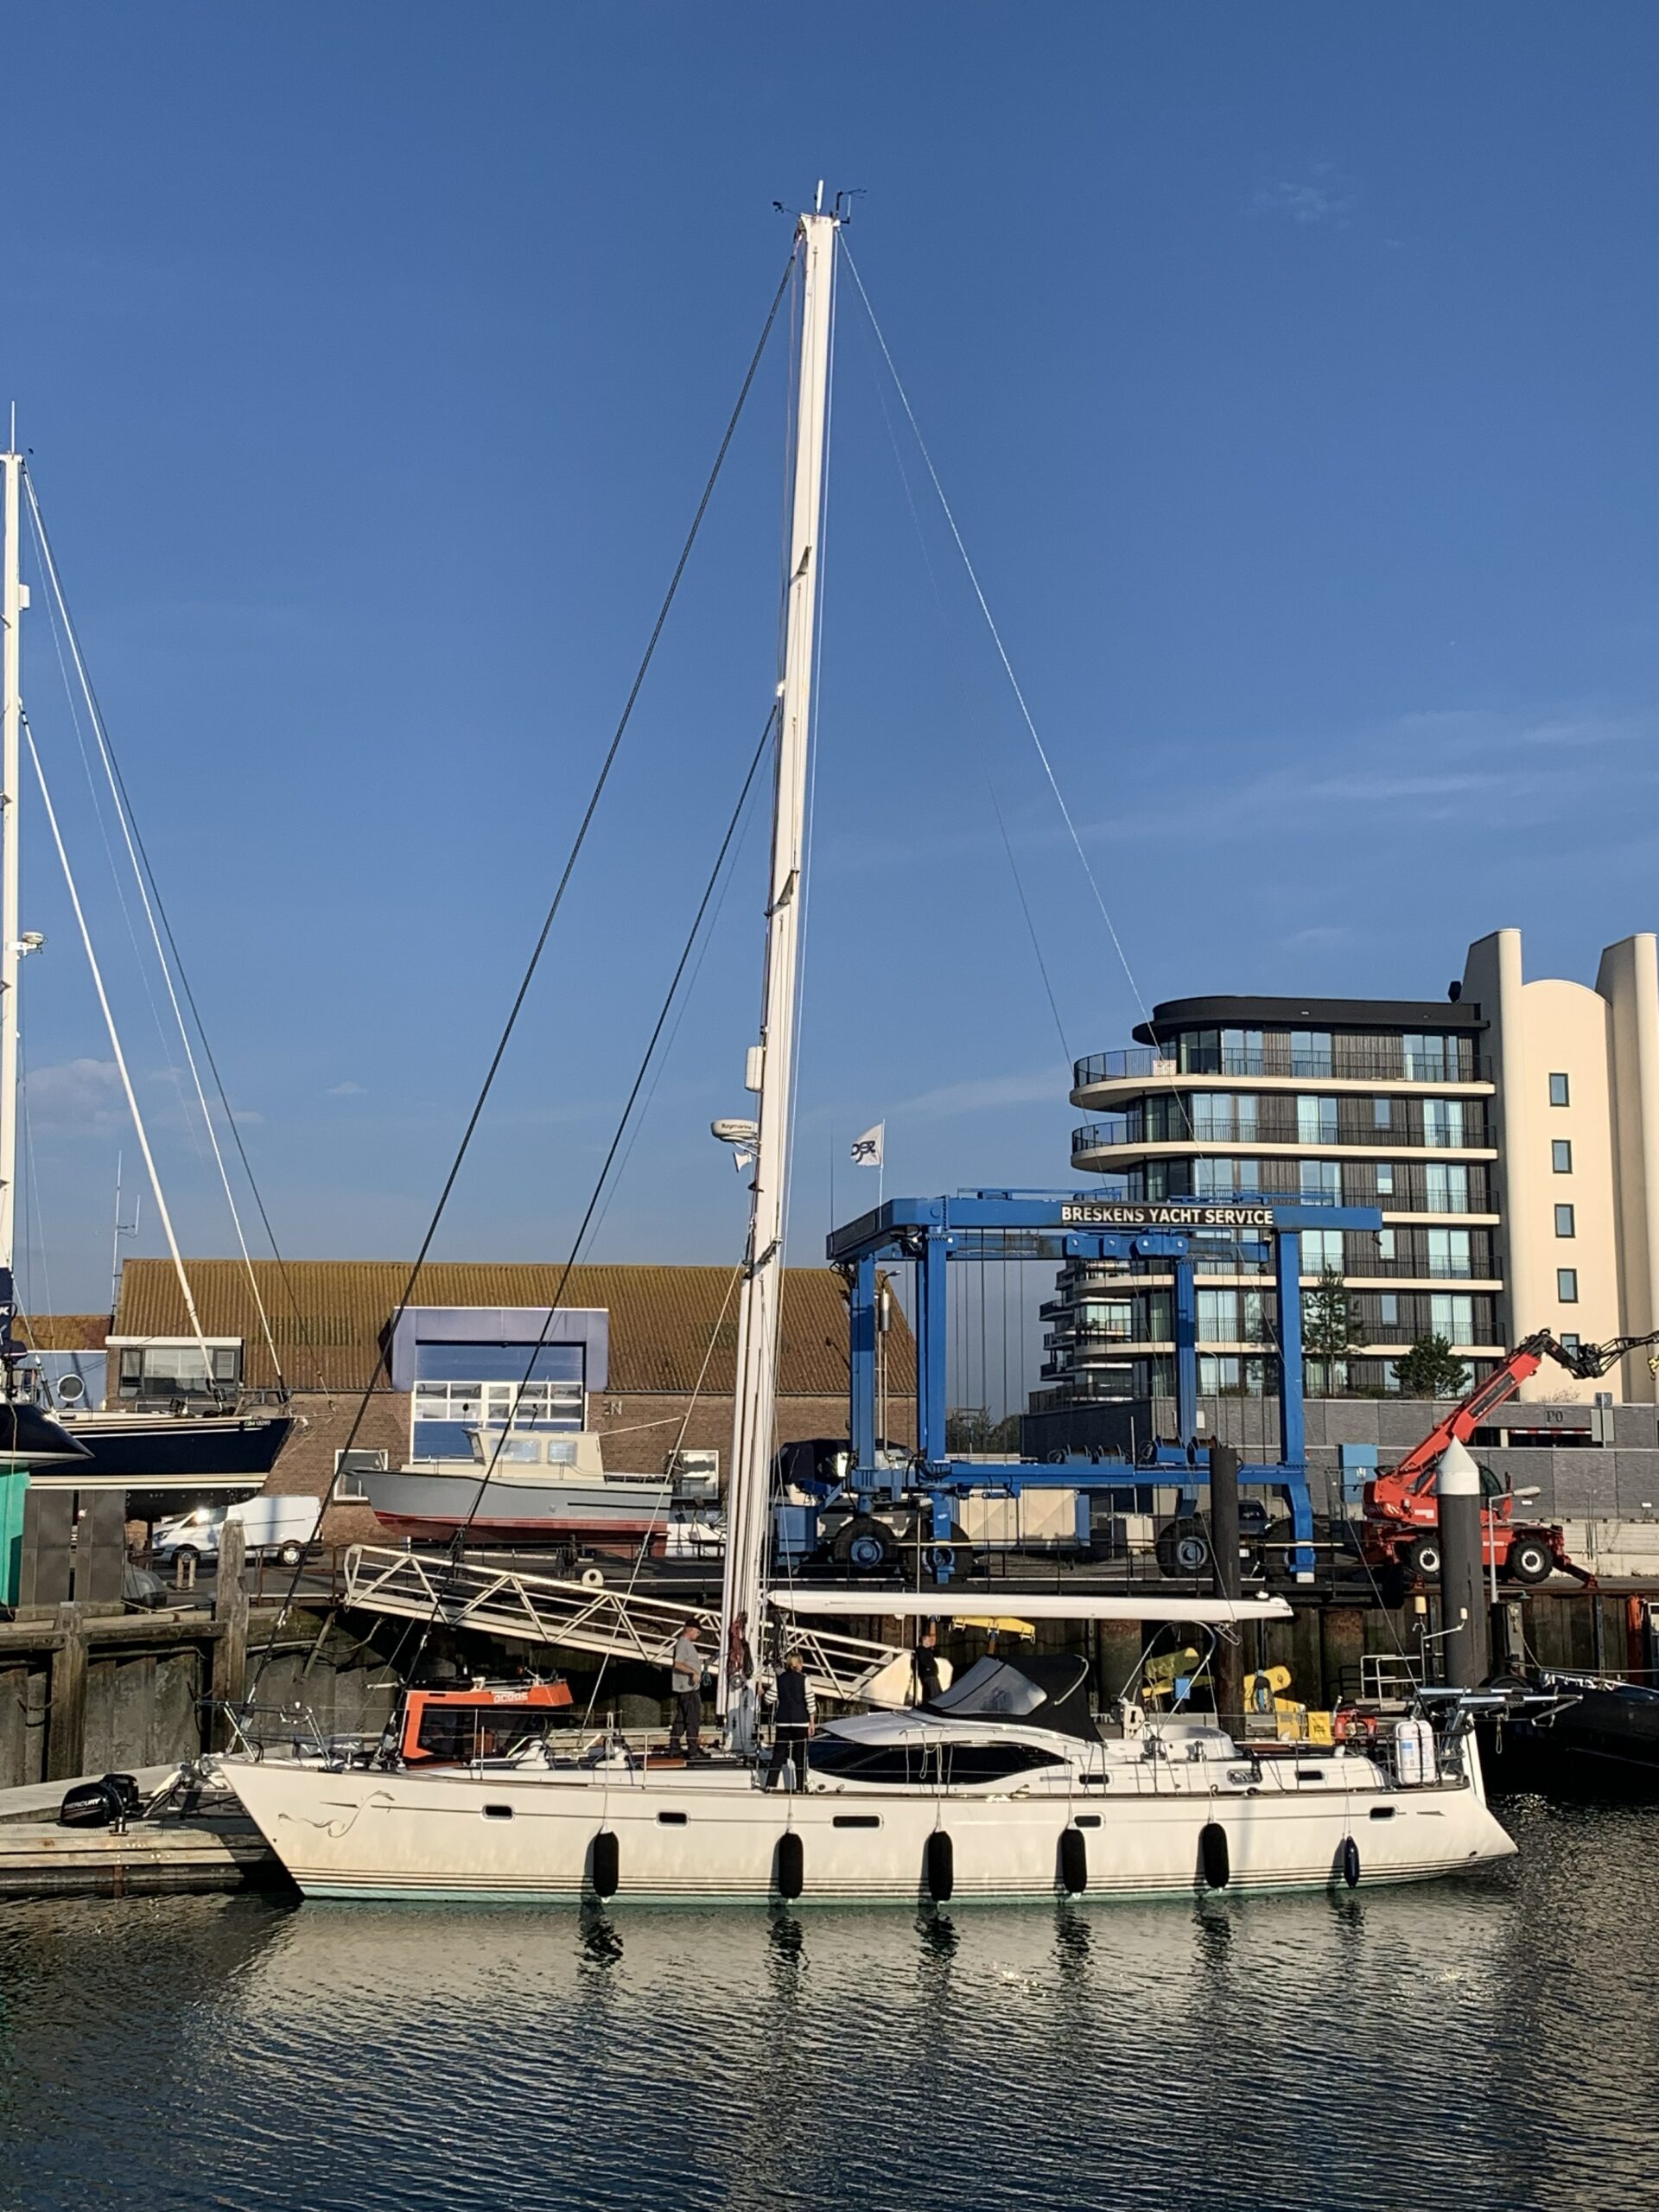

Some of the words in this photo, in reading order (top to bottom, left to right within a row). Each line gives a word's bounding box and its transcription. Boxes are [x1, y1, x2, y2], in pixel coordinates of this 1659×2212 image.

[1062, 1206, 1145, 1223] BRESKENS
[1149, 1208, 1201, 1223] YACHT
[1205, 1210, 1274, 1224] SERVICE
[64, 1797, 101, 1809] MERCURY
